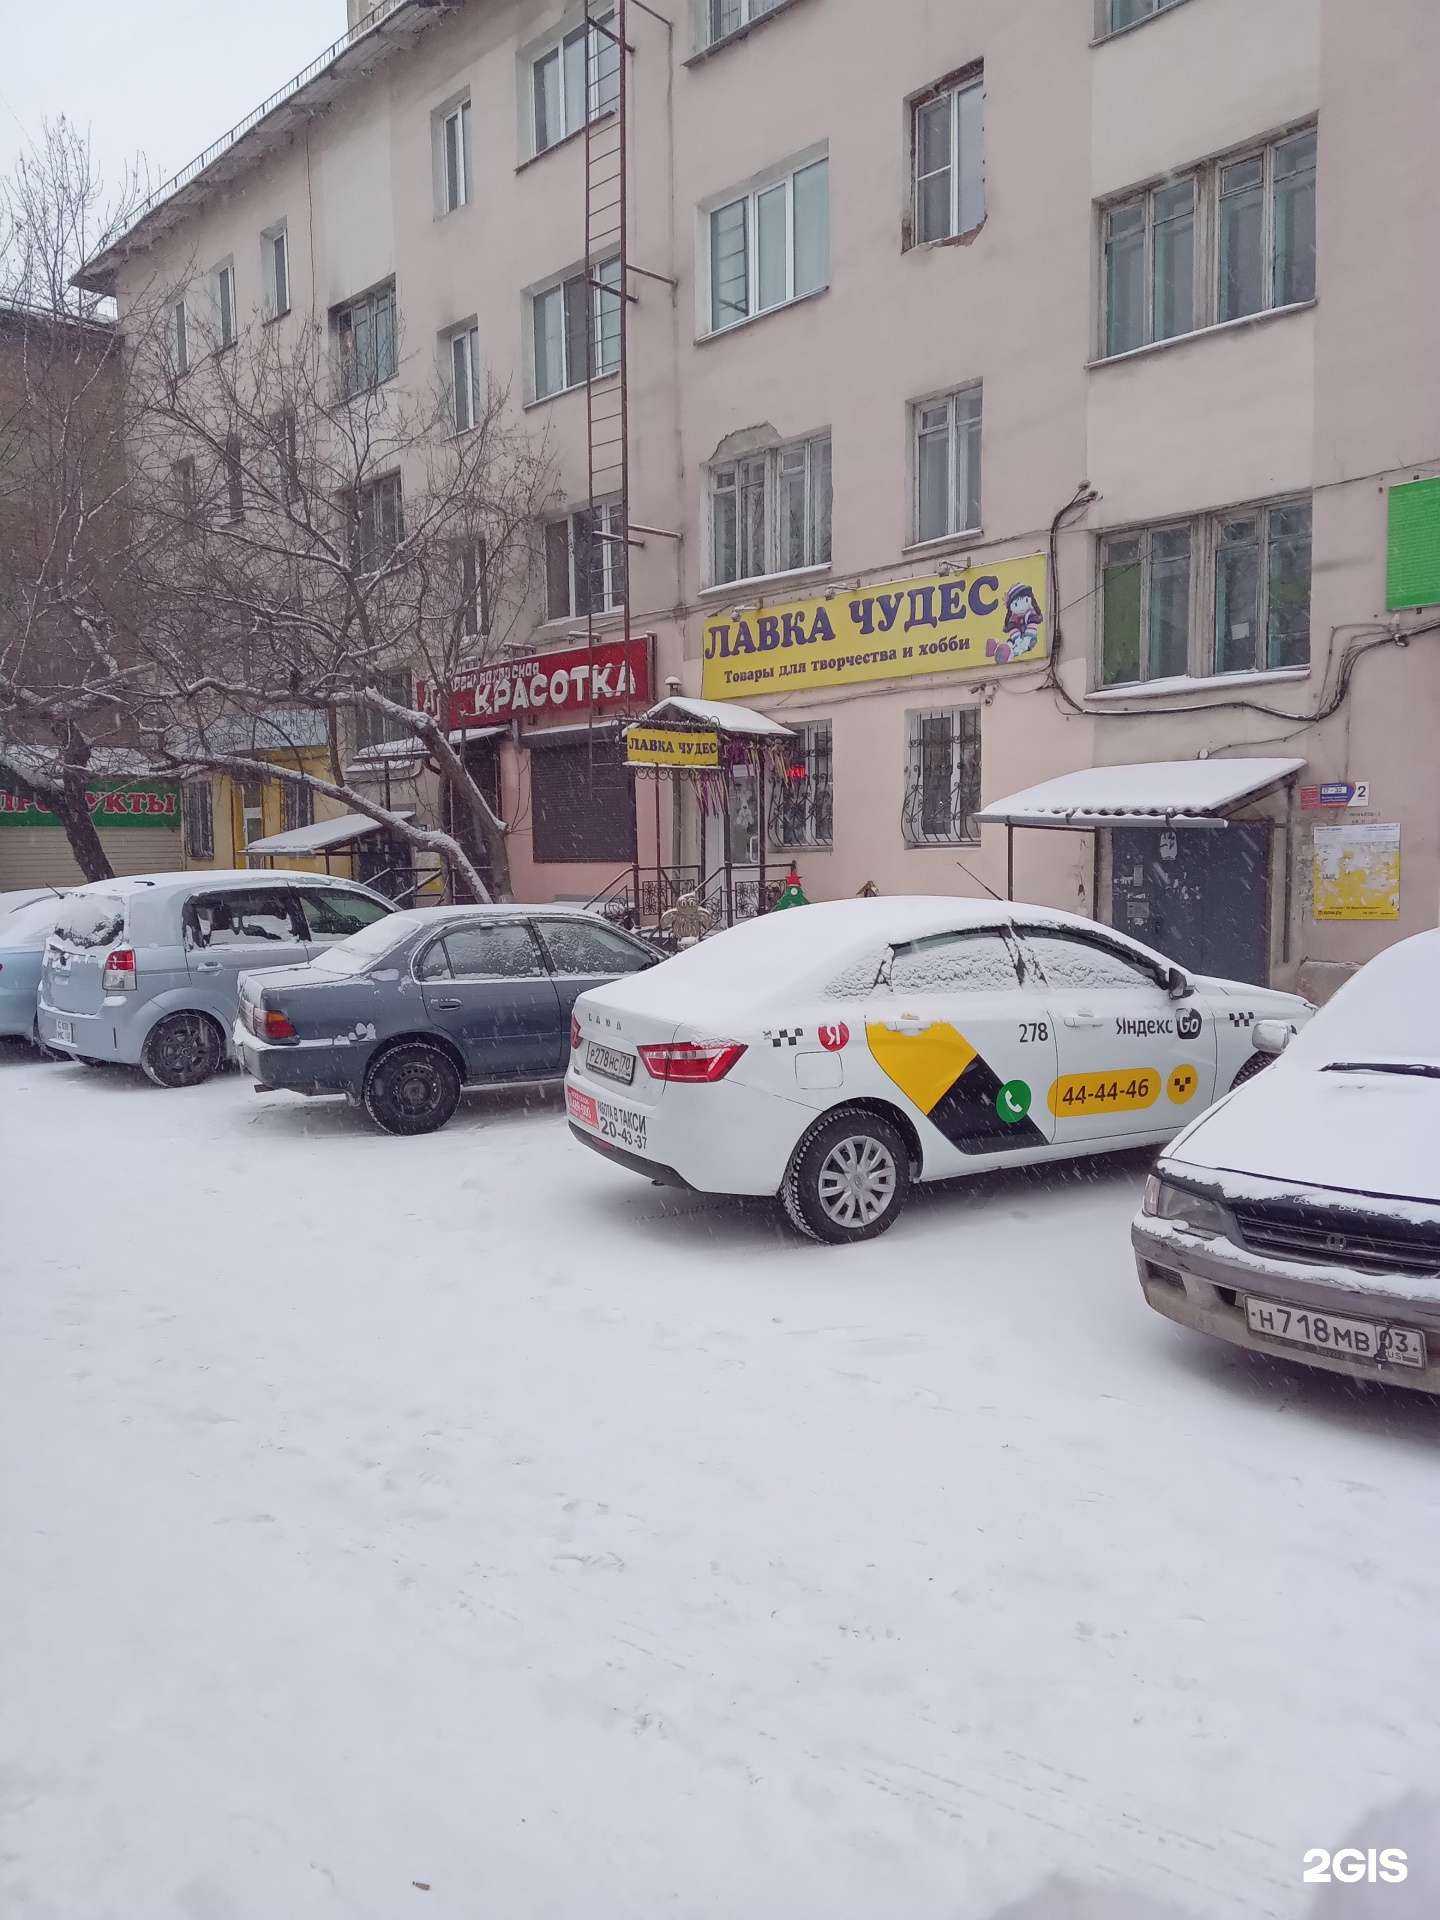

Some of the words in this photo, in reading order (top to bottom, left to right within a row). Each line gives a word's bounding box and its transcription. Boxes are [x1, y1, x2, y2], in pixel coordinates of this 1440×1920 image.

[704, 606, 836, 660] ЛАВКА
[848, 575, 1000, 635] ЧУДЕС
[724, 667, 774, 684] Товары
[779, 662, 807, 679] для
[811, 649, 897, 672] творчества
[902, 646, 913, 658] и
[918, 637, 971, 656] хобби
[474, 660, 636, 715] КРАСОТКА
[628, 738, 675, 753] ЛАВКА
[678, 742, 717, 756] ЧУДЕС
[0, 789, 177, 815] ПРУКТЫ
[1357, 785, 1366, 798] 2
[826, 1024, 841, 1046] Я
[1018, 1022, 1049, 1043] 278
[1116, 1017, 1174, 1037] Яндекс
[1180, 1016, 1200, 1034] Go
[621, 1055, 631, 1071] 70
[1062, 1078, 1149, 1106] 44-44-46
[600, 1116, 648, 1150] 20-43-37
[619, 1109, 647, 1136] ТАКСИ
[1259, 1308, 1370, 1352] Н718МВ
[1379, 1330, 1409, 1353] 03
